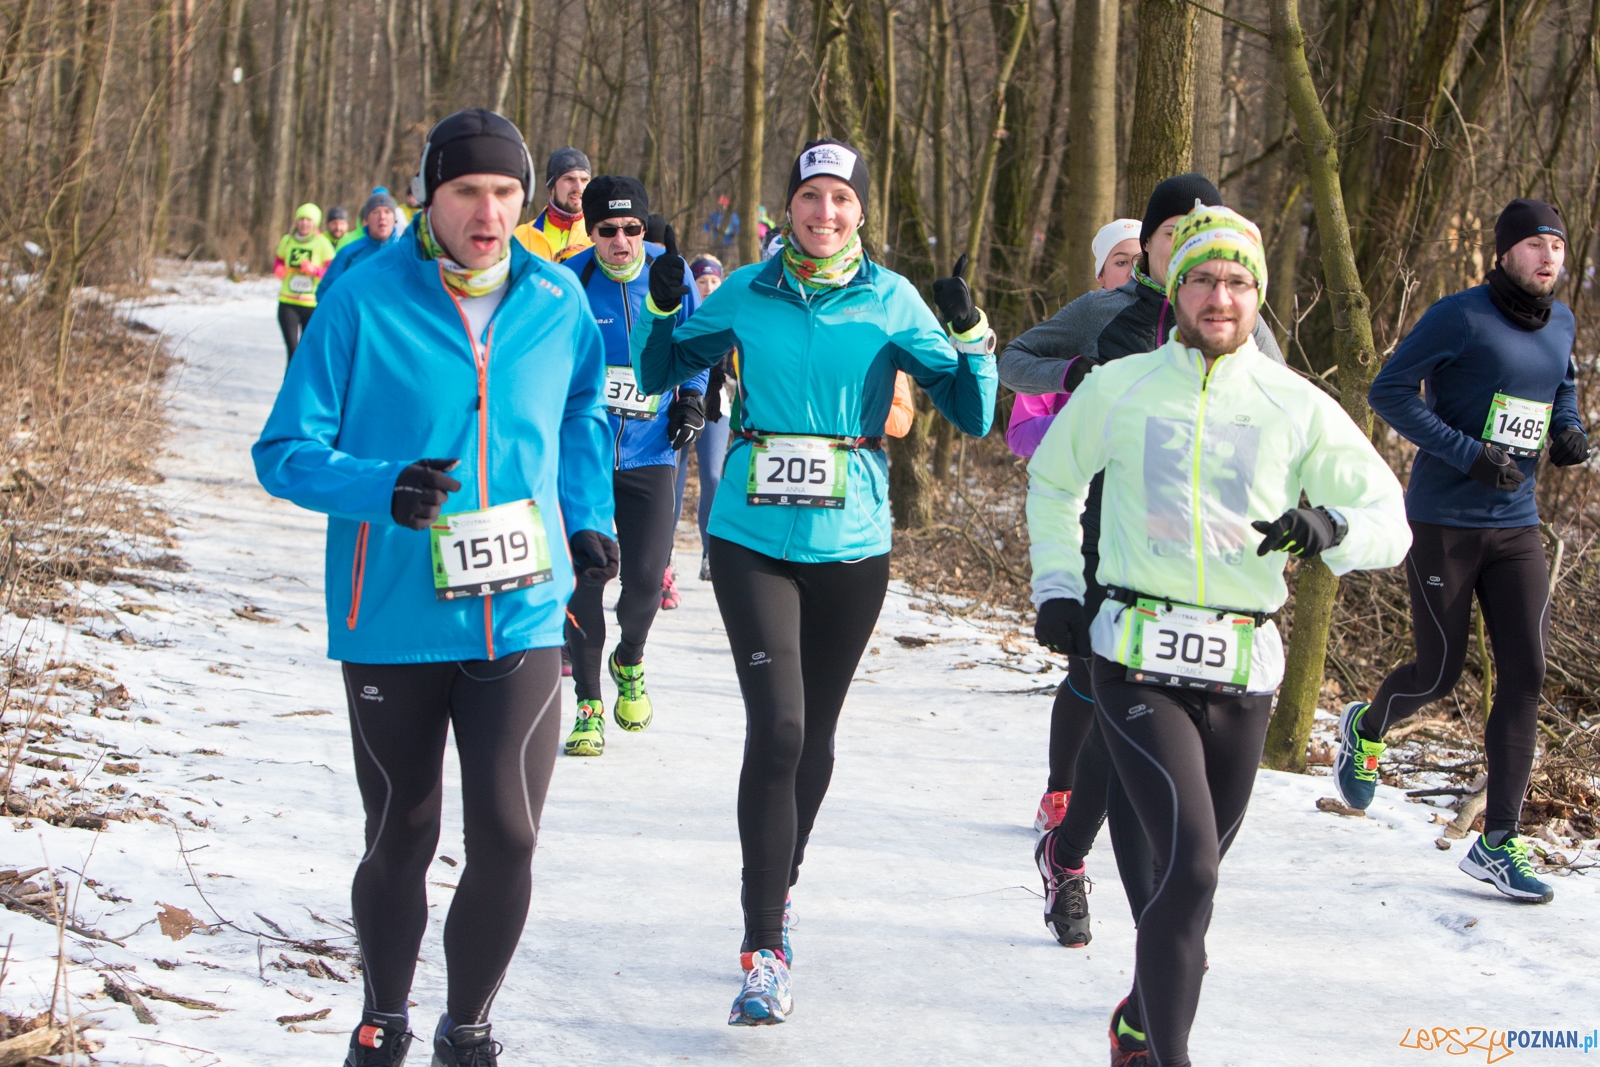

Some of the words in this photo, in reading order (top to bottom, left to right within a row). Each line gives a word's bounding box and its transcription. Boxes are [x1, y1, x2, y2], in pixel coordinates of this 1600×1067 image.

[1499, 413, 1544, 441] 1485
[767, 456, 826, 484] 205
[453, 530, 529, 571] 1519
[485, 568, 509, 579] ADAM
[1156, 629, 1227, 668] 303
[1175, 665, 1204, 677] TOMEK
